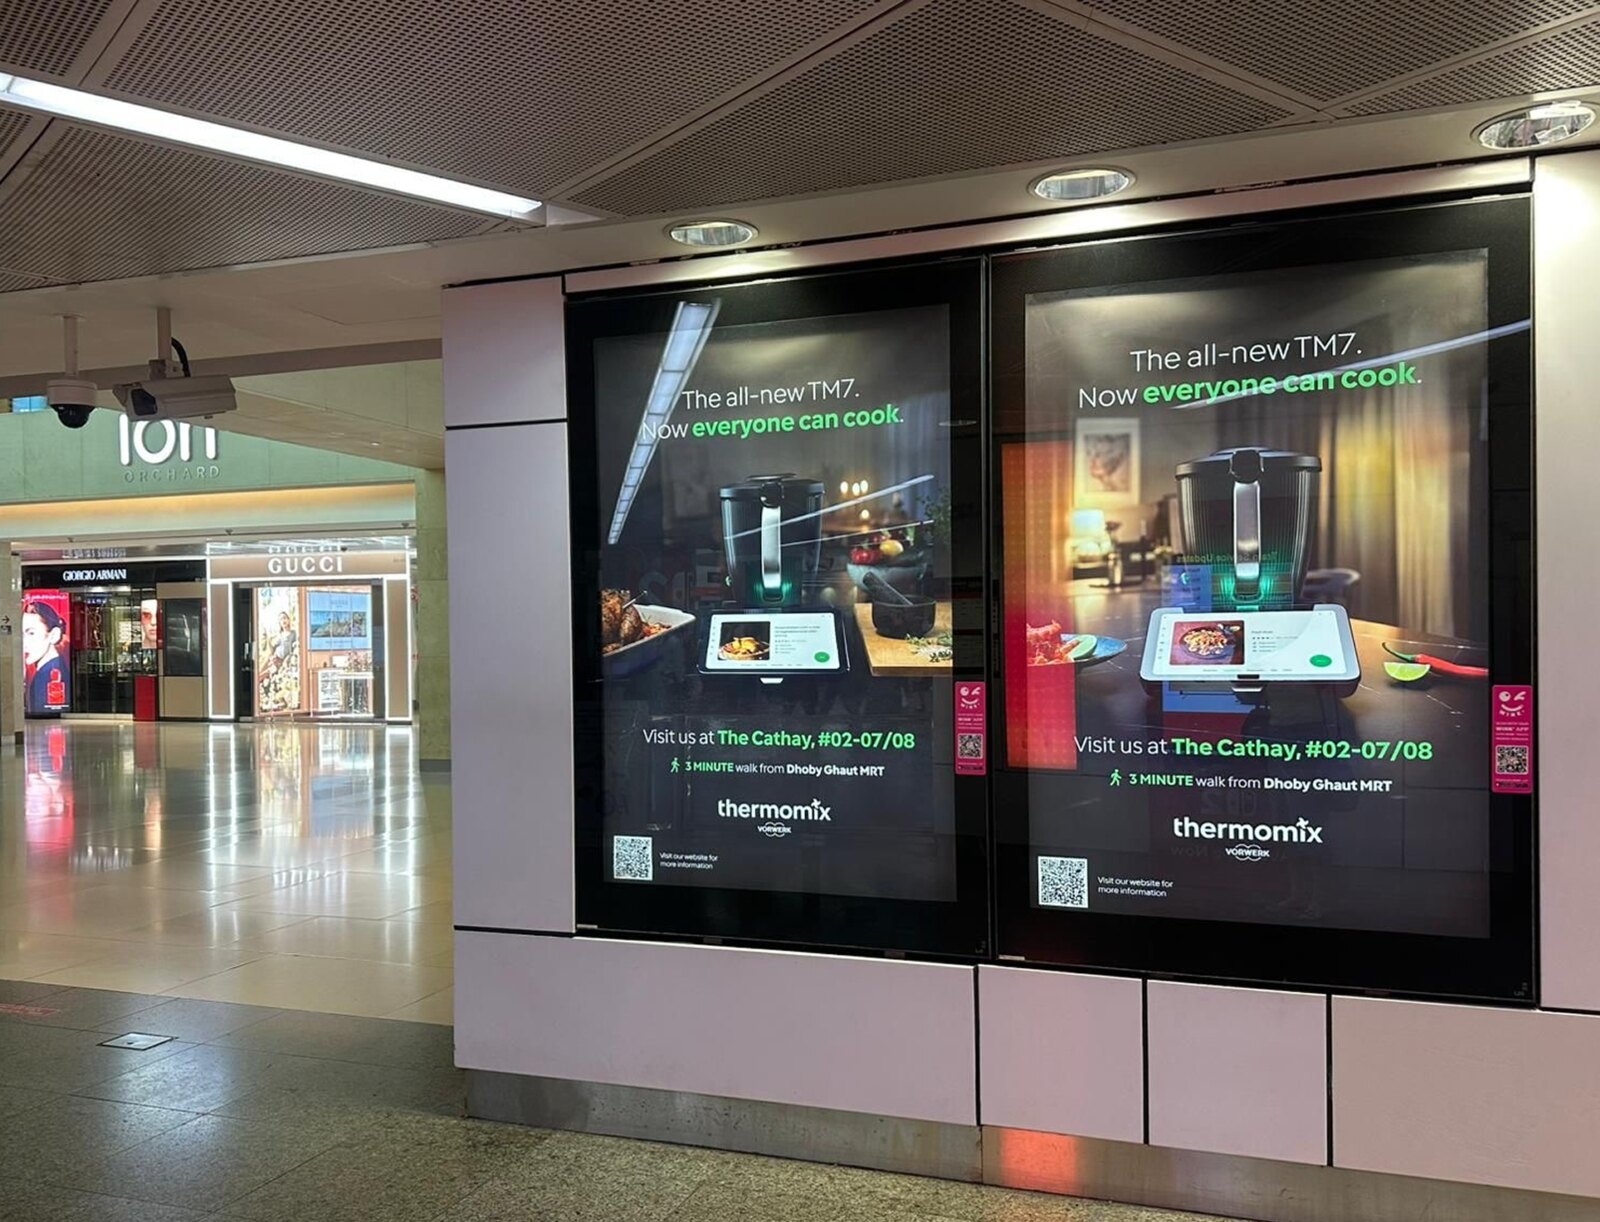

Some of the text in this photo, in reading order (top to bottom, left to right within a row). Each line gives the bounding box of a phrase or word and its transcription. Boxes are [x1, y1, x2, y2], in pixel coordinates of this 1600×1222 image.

[1130, 332, 1363, 372] The all-new TM7.
[1078, 361, 1423, 408] Now everyone can cook.
[682, 378, 860, 410] The all-new TM7.
[642, 404, 904, 440] Now everyone can cook.
[124, 466, 220, 483] ORCHARD
[268, 556, 343, 574] GUCCI
[63, 569, 126, 581] GIORGIO ARMANI
[643, 728, 915, 750] Visit us at The Cathay, #02-07/08
[1074, 735, 1433, 762] Visit us at The Cathay, #02-07/08
[685, 761, 884, 777] 3 MINUTE walk from Dhoby Ghaut MRT
[1128, 774, 1392, 793] 3 MINUTE walk from Dhoby Ghaut MRT
[718, 798, 831, 821] thermomix
[757, 824, 792, 834] VORWERK
[1173, 816, 1323, 844] thermomix
[1225, 846, 1271, 858] VORWERK
[677, 861, 713, 869] information
[1098, 876, 1114, 884] Visit
[1129, 879, 1160, 887] website
[1120, 887, 1166, 897] information
